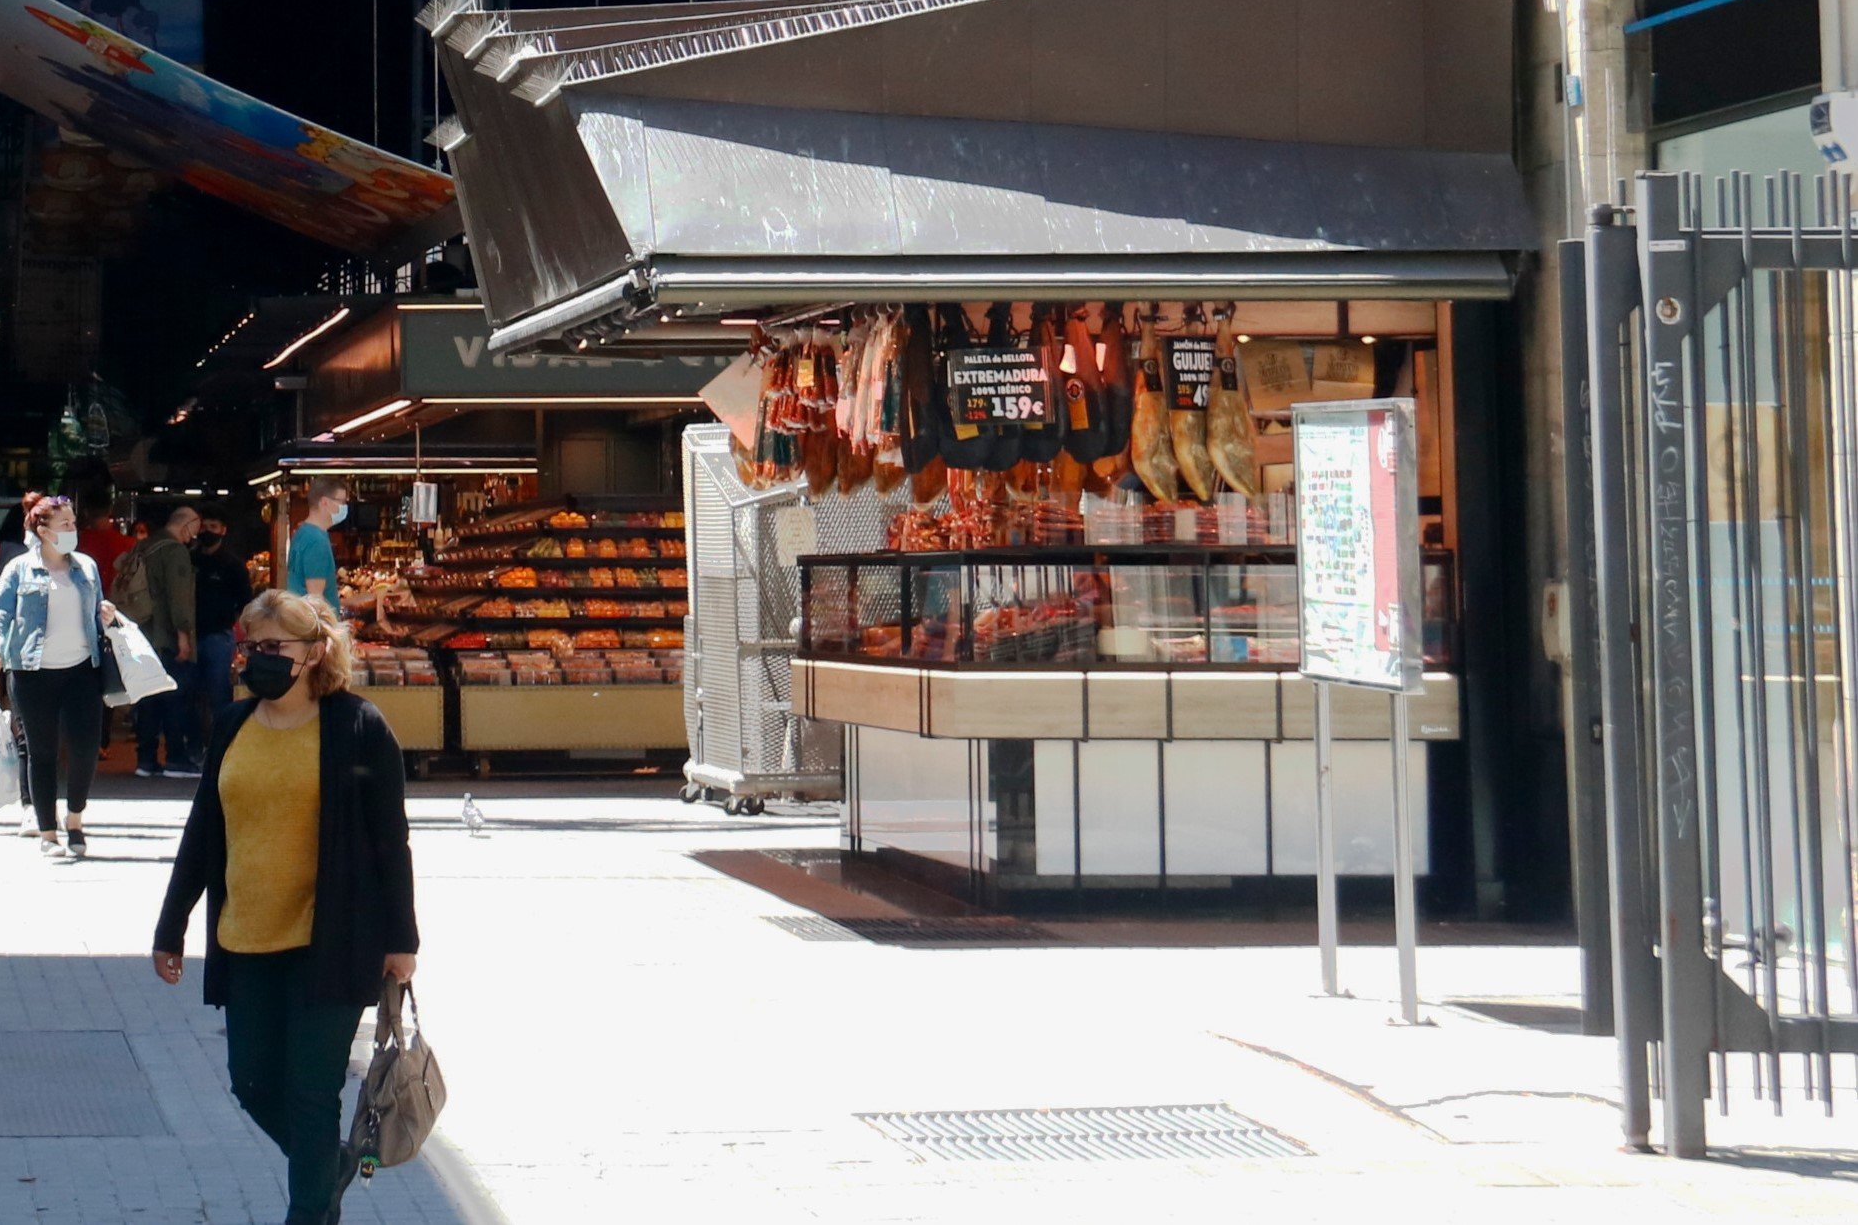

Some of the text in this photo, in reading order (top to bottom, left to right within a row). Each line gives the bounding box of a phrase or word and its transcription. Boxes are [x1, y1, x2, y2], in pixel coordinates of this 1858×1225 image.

[964, 355, 991, 364] PALETA
[1003, 353, 1035, 363] BELLOTA
[954, 368, 1048, 384] EXTREMADURA
[1179, 372, 1197, 382] 100%
[971, 383, 1032, 395] 100% IBÉRICO
[991, 395, 1044, 419] 159€
